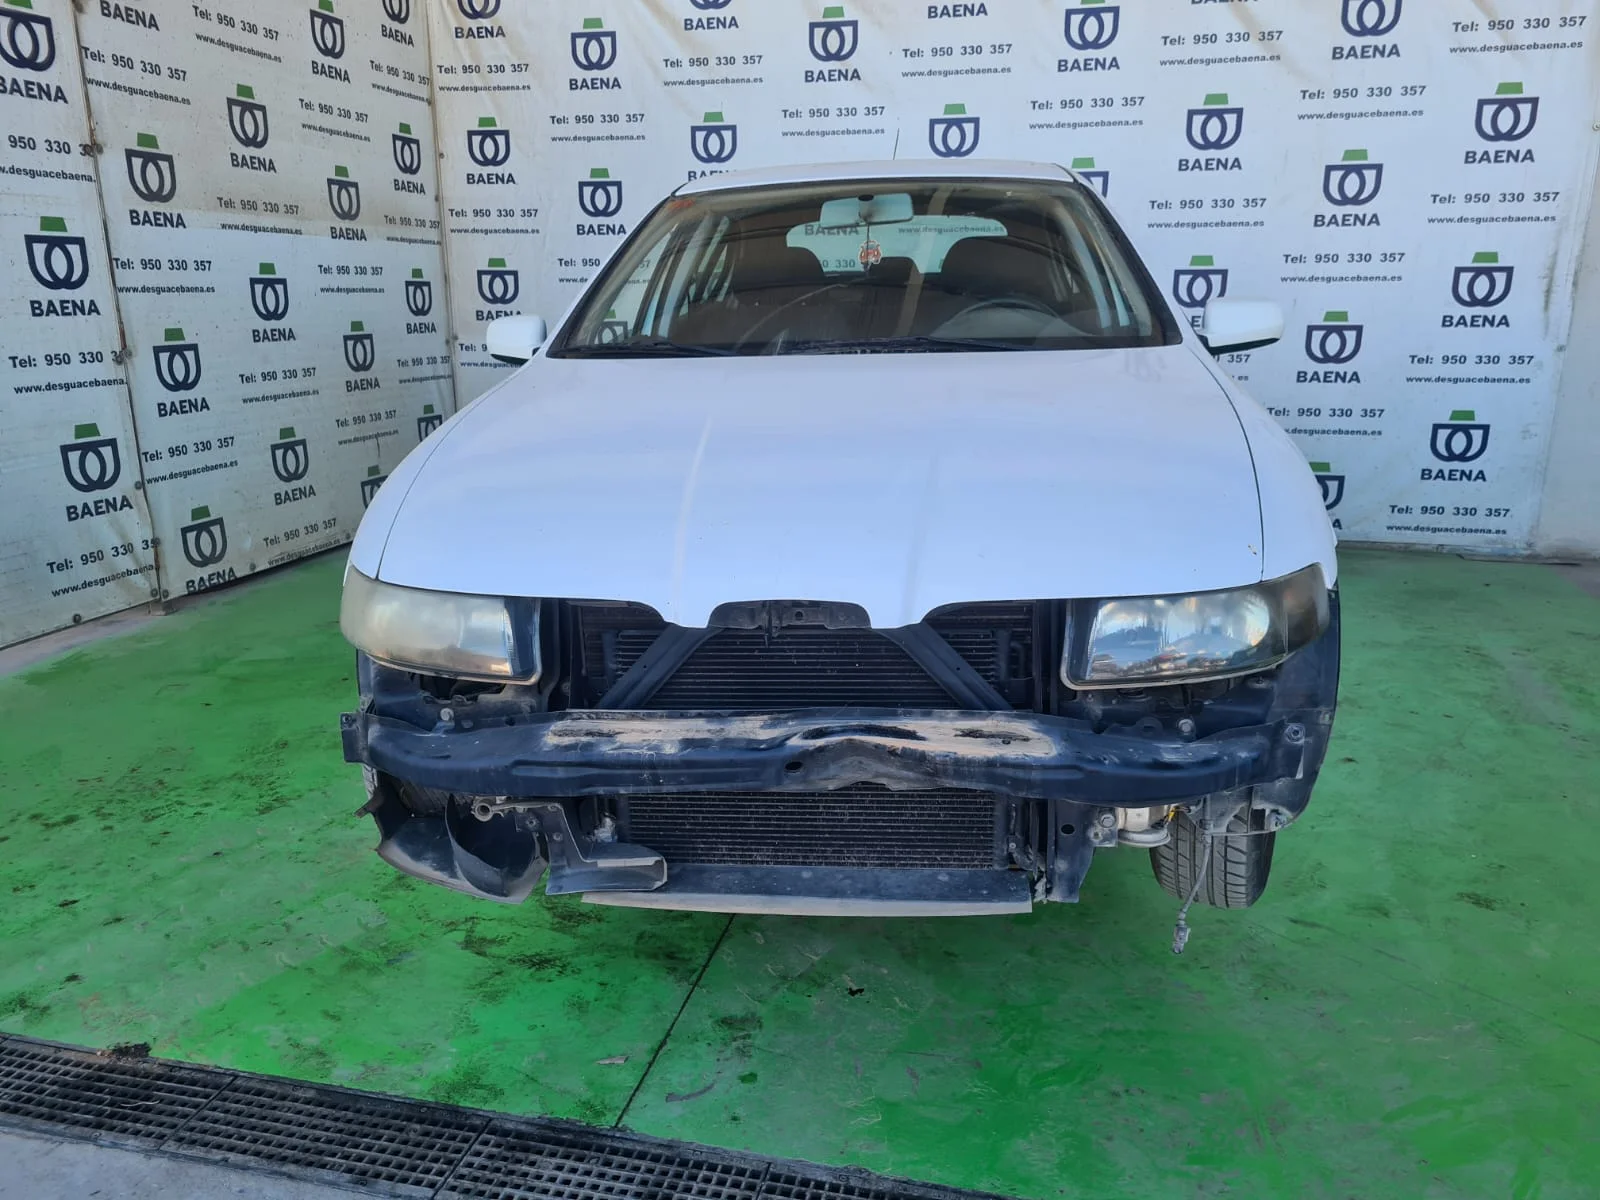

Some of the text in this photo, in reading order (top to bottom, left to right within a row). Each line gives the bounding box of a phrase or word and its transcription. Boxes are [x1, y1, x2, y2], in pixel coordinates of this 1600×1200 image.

[100, 1, 160, 32] BAENA
[928, 3, 988, 19] BAENA
[192, 5, 280, 42] Tel: 950 330 357
[684, 16, 739, 31] BAENA
[1452, 16, 1587, 32] Tel: 950 330 357
[381, 24, 414, 48] BAENA
[455, 25, 506, 39] BAENA
[1161, 31, 1283, 46] Tel: 950 330 357
[902, 44, 1012, 58] Tel: 950 330 357
[1332, 44, 1400, 60] BAENA
[1450, 42, 1583, 53] www.desguacebaena.es
[84, 47, 188, 82] Tel: 950 330 357
[663, 55, 762, 68] Tel: 950 330 357
[1057, 57, 1120, 72] BAENA
[1160, 55, 1280, 66] www.desguacebaena.es
[312, 60, 351, 84] BAENA
[437, 64, 529, 74] Tel: 950 330 357
[805, 68, 861, 83] BAENA
[902, 67, 1011, 77] www.desguacebaena.es
[569, 77, 621, 91] BAENA
[664, 77, 763, 87] www.desguacebaena.es
[0, 75, 69, 104] BAENA
[1300, 85, 1426, 100] Tel: 950 330 357
[1031, 96, 1144, 110] Tel: 950 330 357
[299, 98, 369, 123] Tel: 950 330 357
[782, 106, 885, 118] Tel: 950 330 357
[1298, 109, 1423, 120] www.desguacebaena.es
[550, 113, 644, 125] Tel: 950 330 357
[1029, 120, 1143, 129] www.desguacebaena.es
[782, 128, 885, 137] www.desguacebaena.es
[8, 135, 37, 150] 950
[44, 139, 71, 155] 330
[230, 152, 277, 173] BAENA
[1464, 149, 1535, 164] BAENA
[1178, 157, 1242, 171] BAENA
[466, 173, 516, 184] BAENA
[394, 179, 426, 195] BAENA
[1149, 198, 1267, 210] Tel: 950 330 357
[1431, 192, 1560, 204] Tel: 950 330 357
[217, 197, 299, 215] Tel: 950 330 357
[129, 209, 187, 229] BAENA
[448, 209, 538, 218] Tel: 950 330 357
[1313, 213, 1380, 227] BAENA
[1428, 216, 1556, 224] www.desguacebaena.es
[577, 224, 627, 236] BAENA
[1148, 220, 1264, 229] www.desguacebaena.es
[330, 226, 367, 241] BAENA
[114, 257, 212, 271] Tel: 950 330 357
[557, 258, 600, 267] Tel: 950
[1283, 253, 1405, 264] Tel: 950 330 357
[318, 265, 383, 276] Tel: 950 330 357
[1280, 274, 1402, 284] www.desguacebaena.es
[29, 299, 101, 317] BAENA
[406, 322, 437, 334] BAENA
[1441, 314, 1510, 328] BAENA
[252, 328, 296, 343] BAENA
[459, 343, 476, 352] Tel:
[8, 355, 37, 368] Tel:
[44, 353, 71, 366] 950
[78, 351, 103, 364] 330
[1227, 354, 1251, 363] 357
[1409, 355, 1534, 365] Tel: 950 330 357
[239, 367, 316, 384] Tel: 950 330 357
[1296, 371, 1360, 384] BAENA
[1406, 375, 1531, 384] www.desguacebaena.es
[346, 377, 380, 392] BAENA
[157, 397, 210, 418] BAENA
[1268, 408, 1384, 418] Tel: 950 330 357
[142, 436, 234, 463] Tel: 950 330 357
[1420, 468, 1487, 482] BAENA
[274, 485, 316, 506] BAENA
[66, 495, 134, 522] BAENA
[1389, 505, 1510, 517] Tel: 950 330 357
[1386, 524, 1507, 535] www.desguacebaena.es
[46, 542, 134, 573] Tel: 950 330
